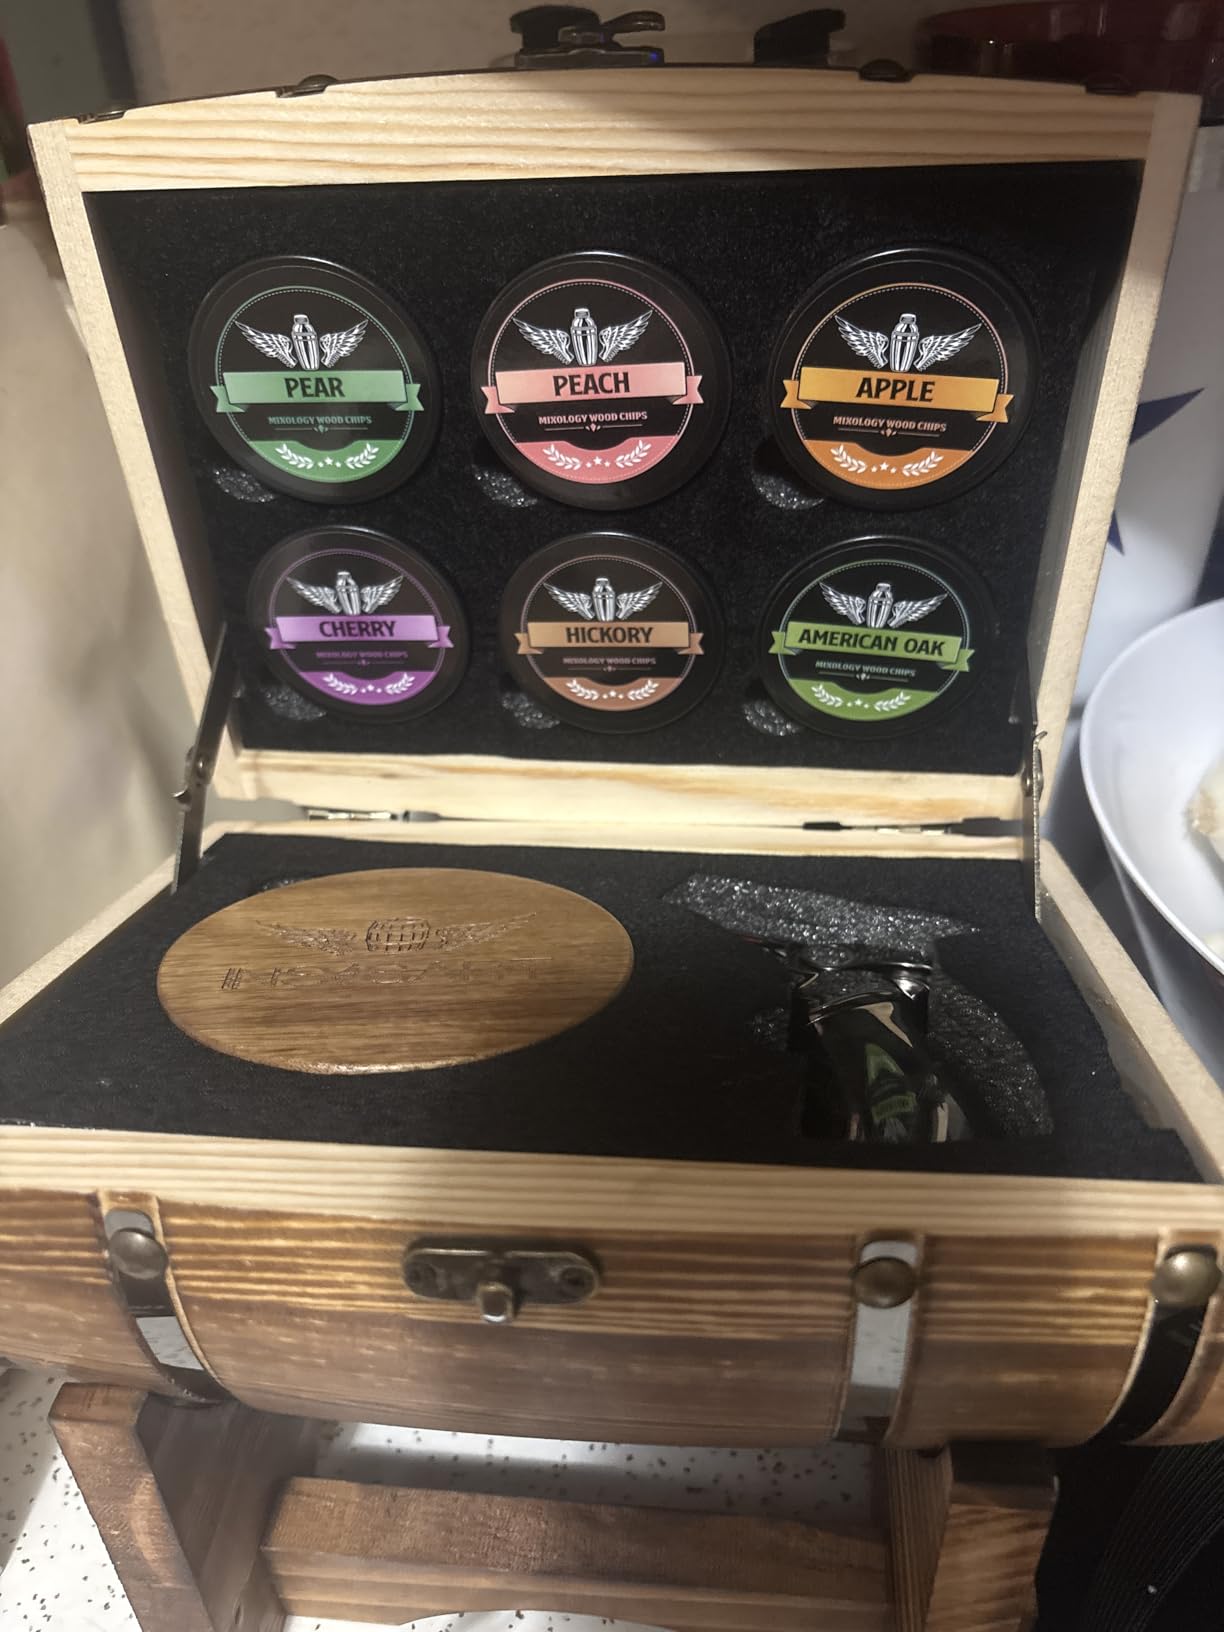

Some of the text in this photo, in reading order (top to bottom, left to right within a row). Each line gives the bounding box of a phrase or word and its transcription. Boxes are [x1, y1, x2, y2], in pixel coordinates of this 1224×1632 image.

[284, 377, 345, 398] PEAR
[552, 372, 630, 396] PEACH
[855, 377, 936, 402] APPLE
[267, 415, 372, 425] MIXOLOGY WOOD CHIPS
[538, 411, 648, 425] MIXOLOGY WOOD CHIPS
[832, 415, 947, 433] MIXOLOGY WOOD CHIPS
[319, 621, 396, 638] CHERRY
[565, 626, 653, 644] HICKORY
[798, 629, 946, 657] AMERICAN OAK
[815, 660, 917, 678] MIXOLOGY WOOD CHIPS
